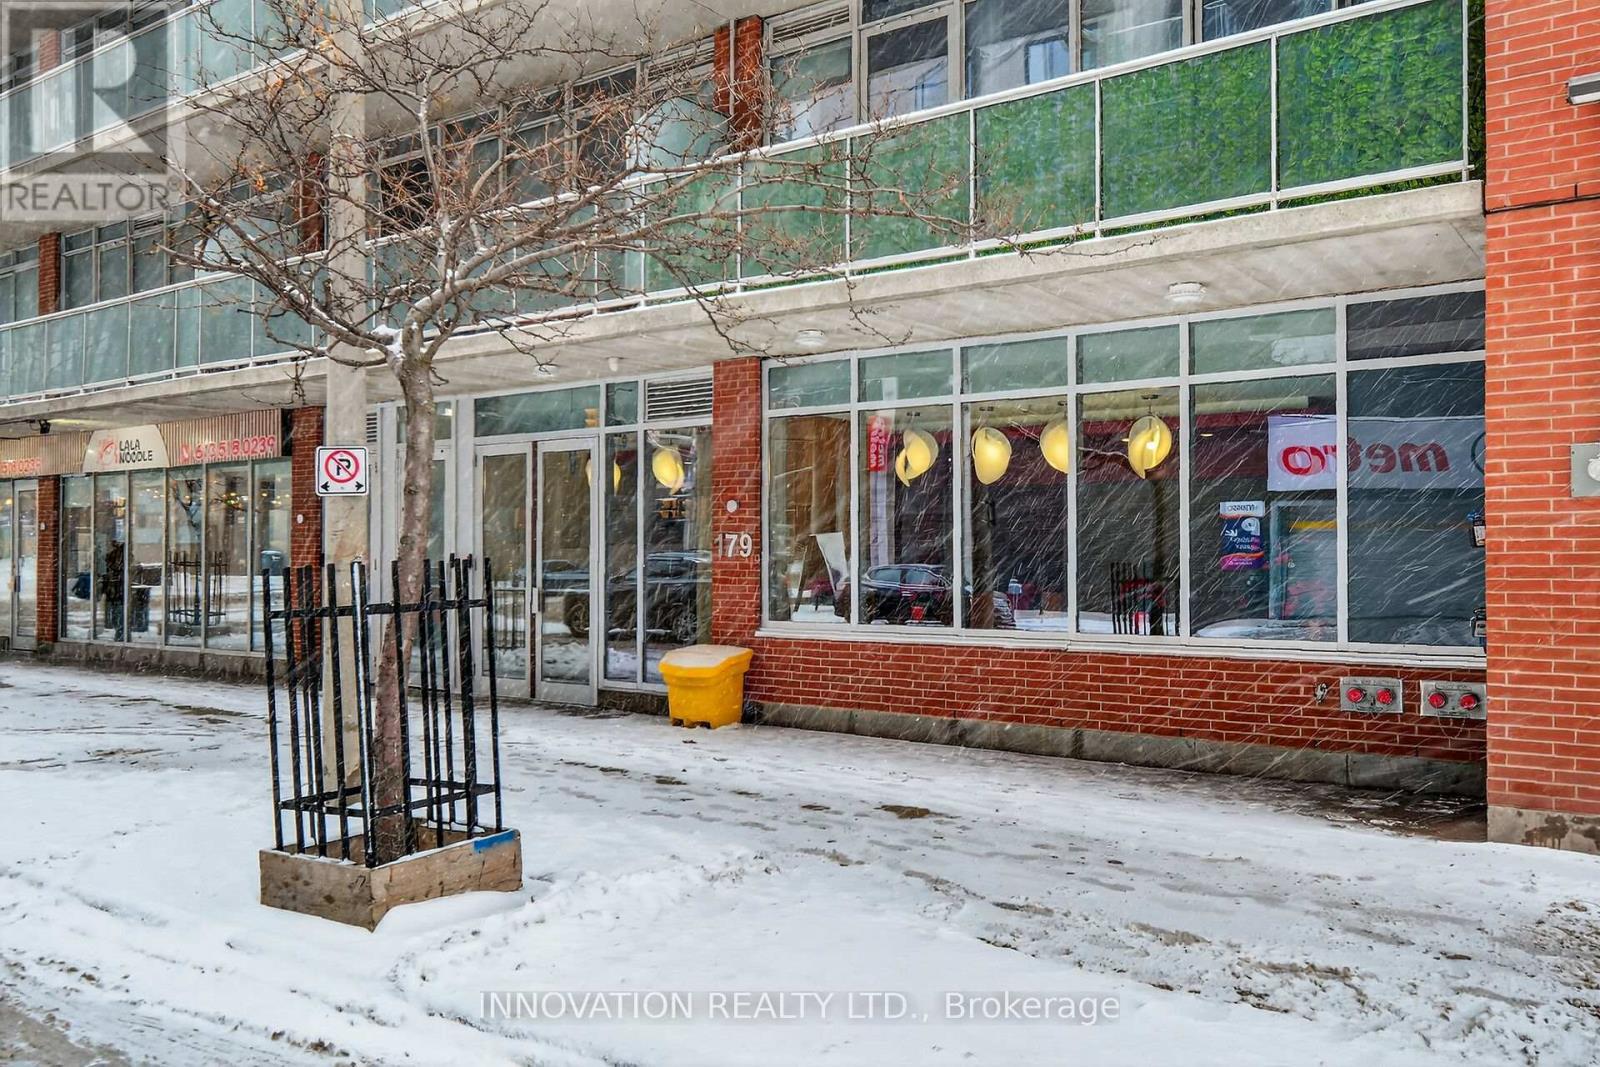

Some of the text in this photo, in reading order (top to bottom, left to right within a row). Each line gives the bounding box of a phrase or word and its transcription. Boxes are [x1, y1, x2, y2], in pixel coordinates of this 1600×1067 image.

[119, 439, 141, 452] LALA
[119, 450, 153, 464] NOODLE
[713, 533, 752, 558] 179
